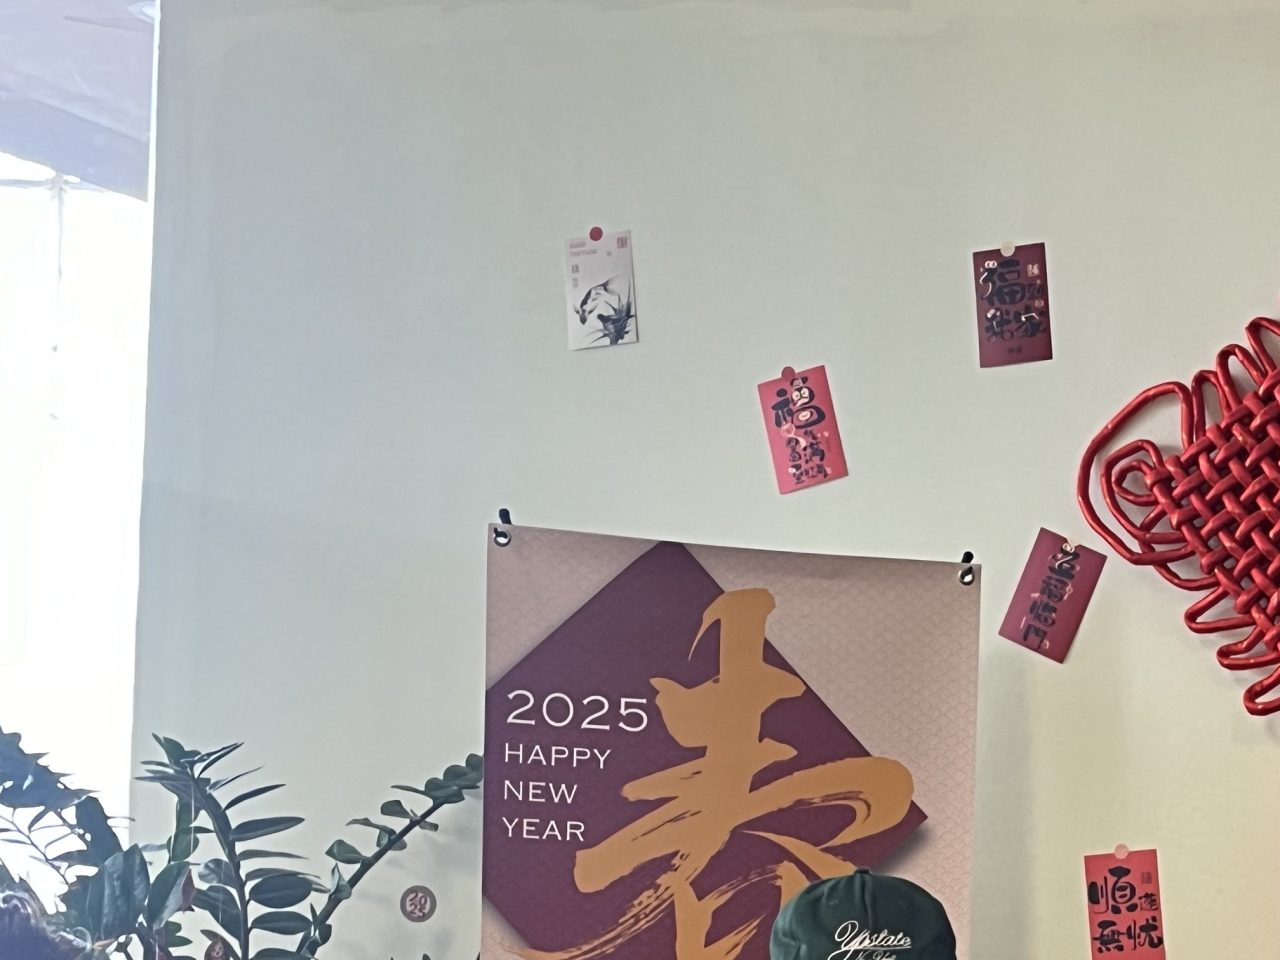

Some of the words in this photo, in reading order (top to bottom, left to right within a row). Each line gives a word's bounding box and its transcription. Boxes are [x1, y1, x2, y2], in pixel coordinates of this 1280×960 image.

[506, 689, 649, 732] 2025
[504, 742, 611, 769] HAPPY
[503, 781, 578, 804] NEW
[502, 816, 586, 842] YEAR
